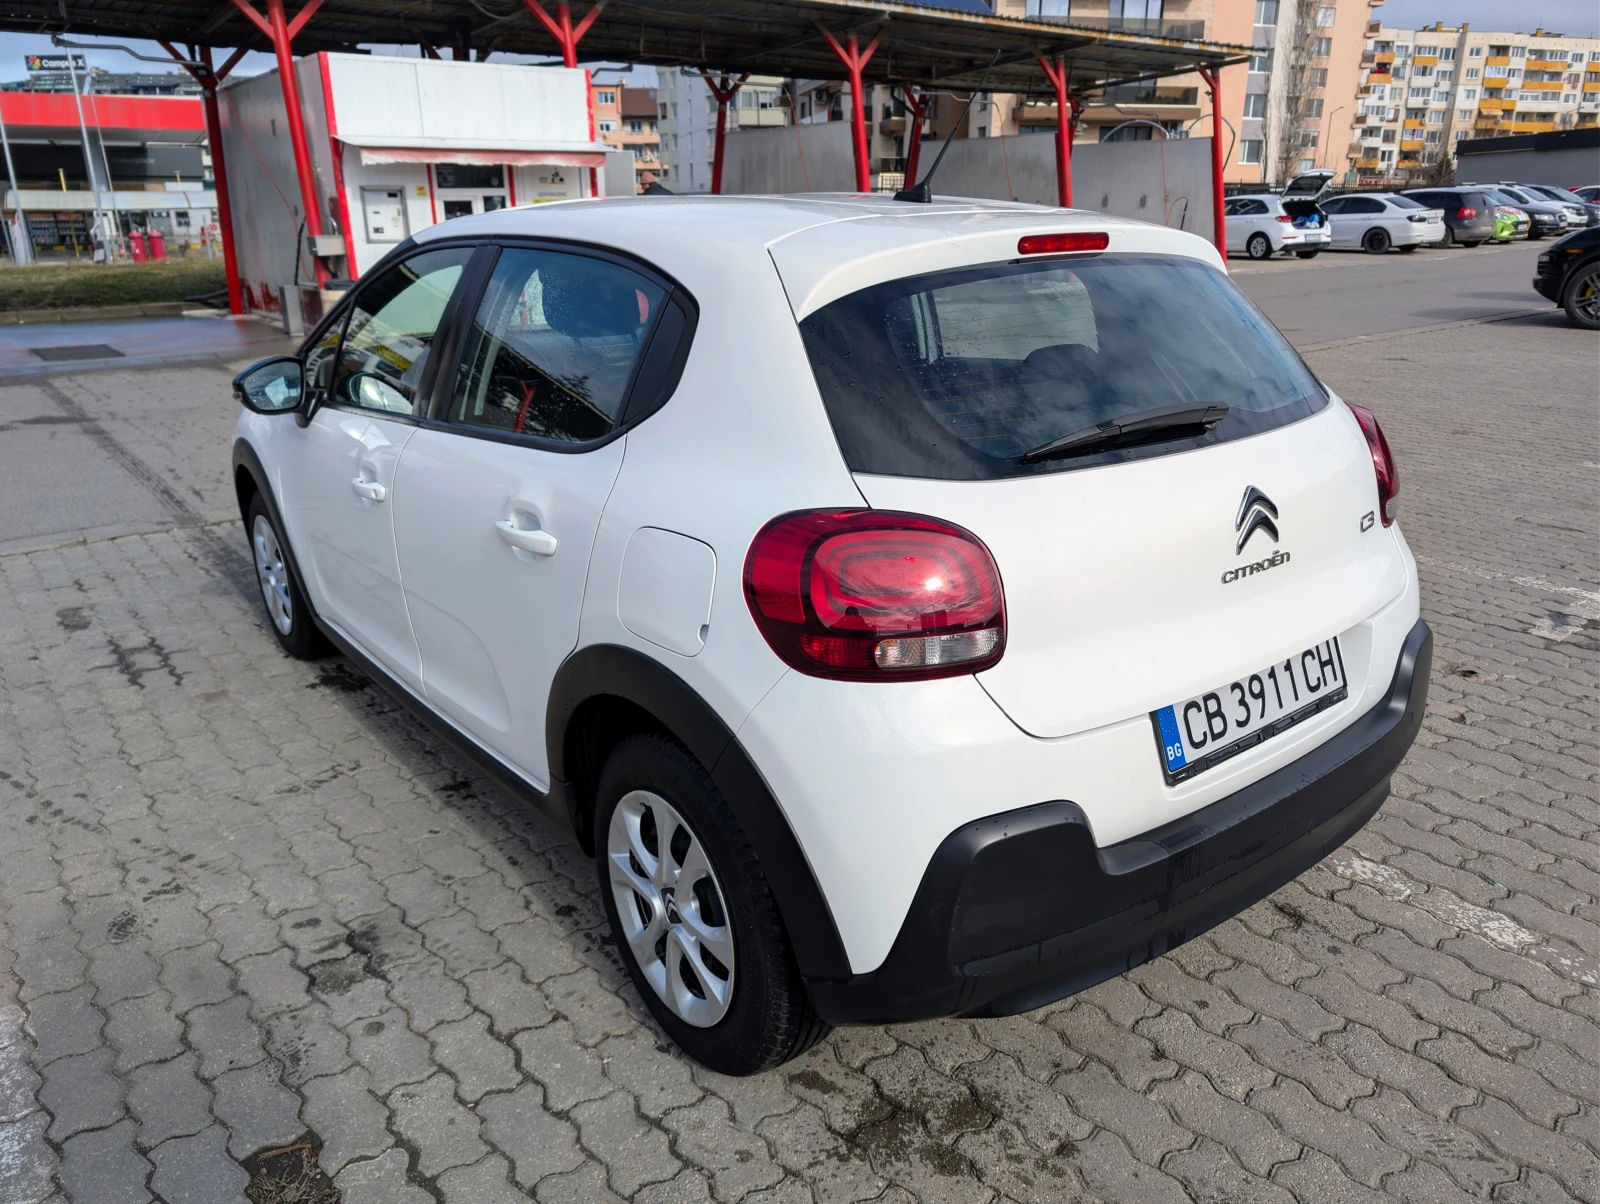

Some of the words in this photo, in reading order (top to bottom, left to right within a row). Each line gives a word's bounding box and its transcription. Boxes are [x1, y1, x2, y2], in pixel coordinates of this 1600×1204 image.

[77, 58, 84, 67] X
[1183, 692, 1228, 750] CB
[1230, 658, 1299, 728] 3911
[1301, 636, 1338, 693] CH
[1166, 743, 1183, 761] BG
